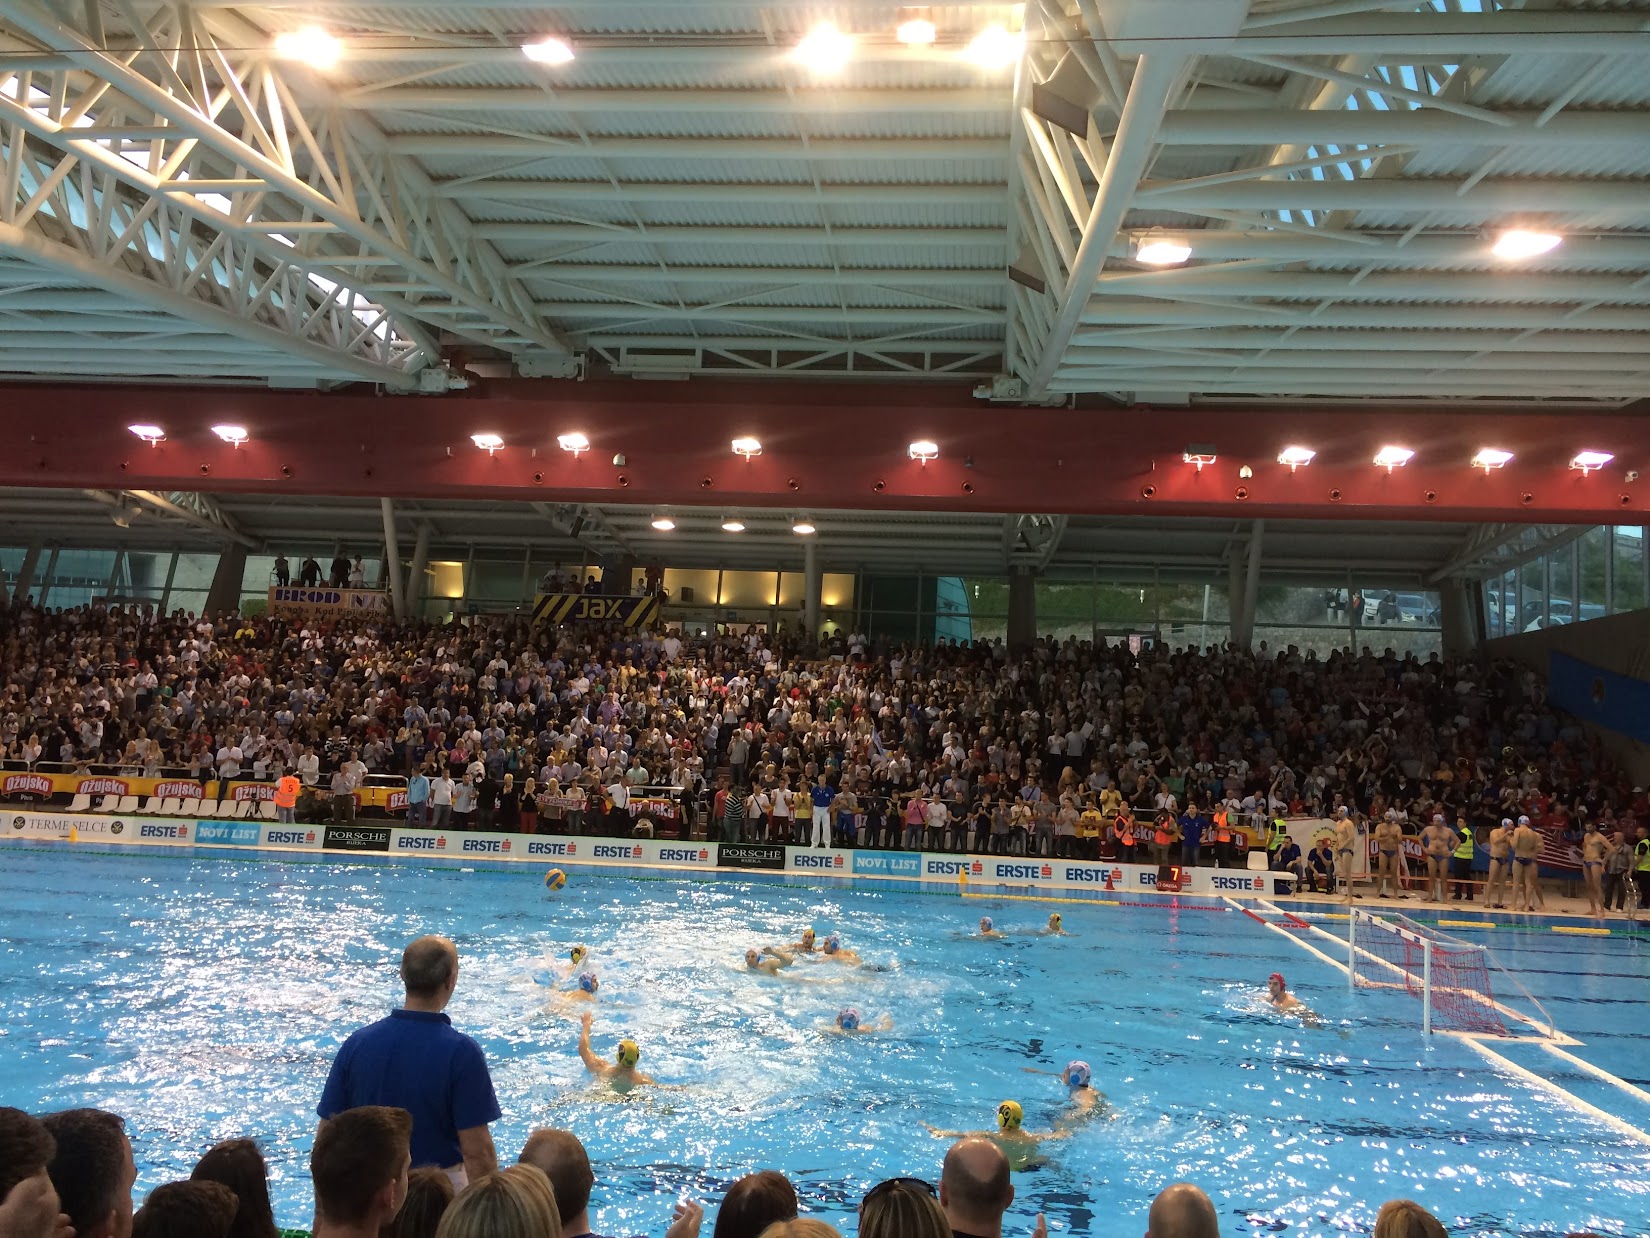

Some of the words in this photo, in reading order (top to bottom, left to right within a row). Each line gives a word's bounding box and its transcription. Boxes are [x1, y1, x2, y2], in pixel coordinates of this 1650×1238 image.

[275, 588, 341, 604] BROD
[7, 775, 50, 793] Ožujsko
[158, 780, 202, 798] Ožujsko
[287, 784, 294, 793] 5
[29, 818, 70, 831] TERME
[141, 825, 177, 837] ERSTE
[199, 827, 228, 839] NOVI
[231, 829, 257, 840] LIST
[268, 831, 304, 844] ERSTE
[328, 831, 386, 841] PORSCHE
[398, 836, 435, 849] ERSTE
[463, 839, 500, 852] ERSTE
[528, 842, 565, 855] ERSTE
[594, 845, 631, 858] ERSTE
[660, 849, 697, 861] ERSTE
[722, 848, 781, 859] PORSCHE
[794, 855, 832, 868] ERSTE
[857, 857, 887, 868] NOVI
[890, 859, 917, 870] LIST
[927, 861, 970, 875] ERSTE
[996, 864, 1039, 879] ERSTE
[1066, 868, 1109, 882] ERSTE
[1170, 868, 1179, 881] 7
[1211, 876, 1252, 890] ERSTE
